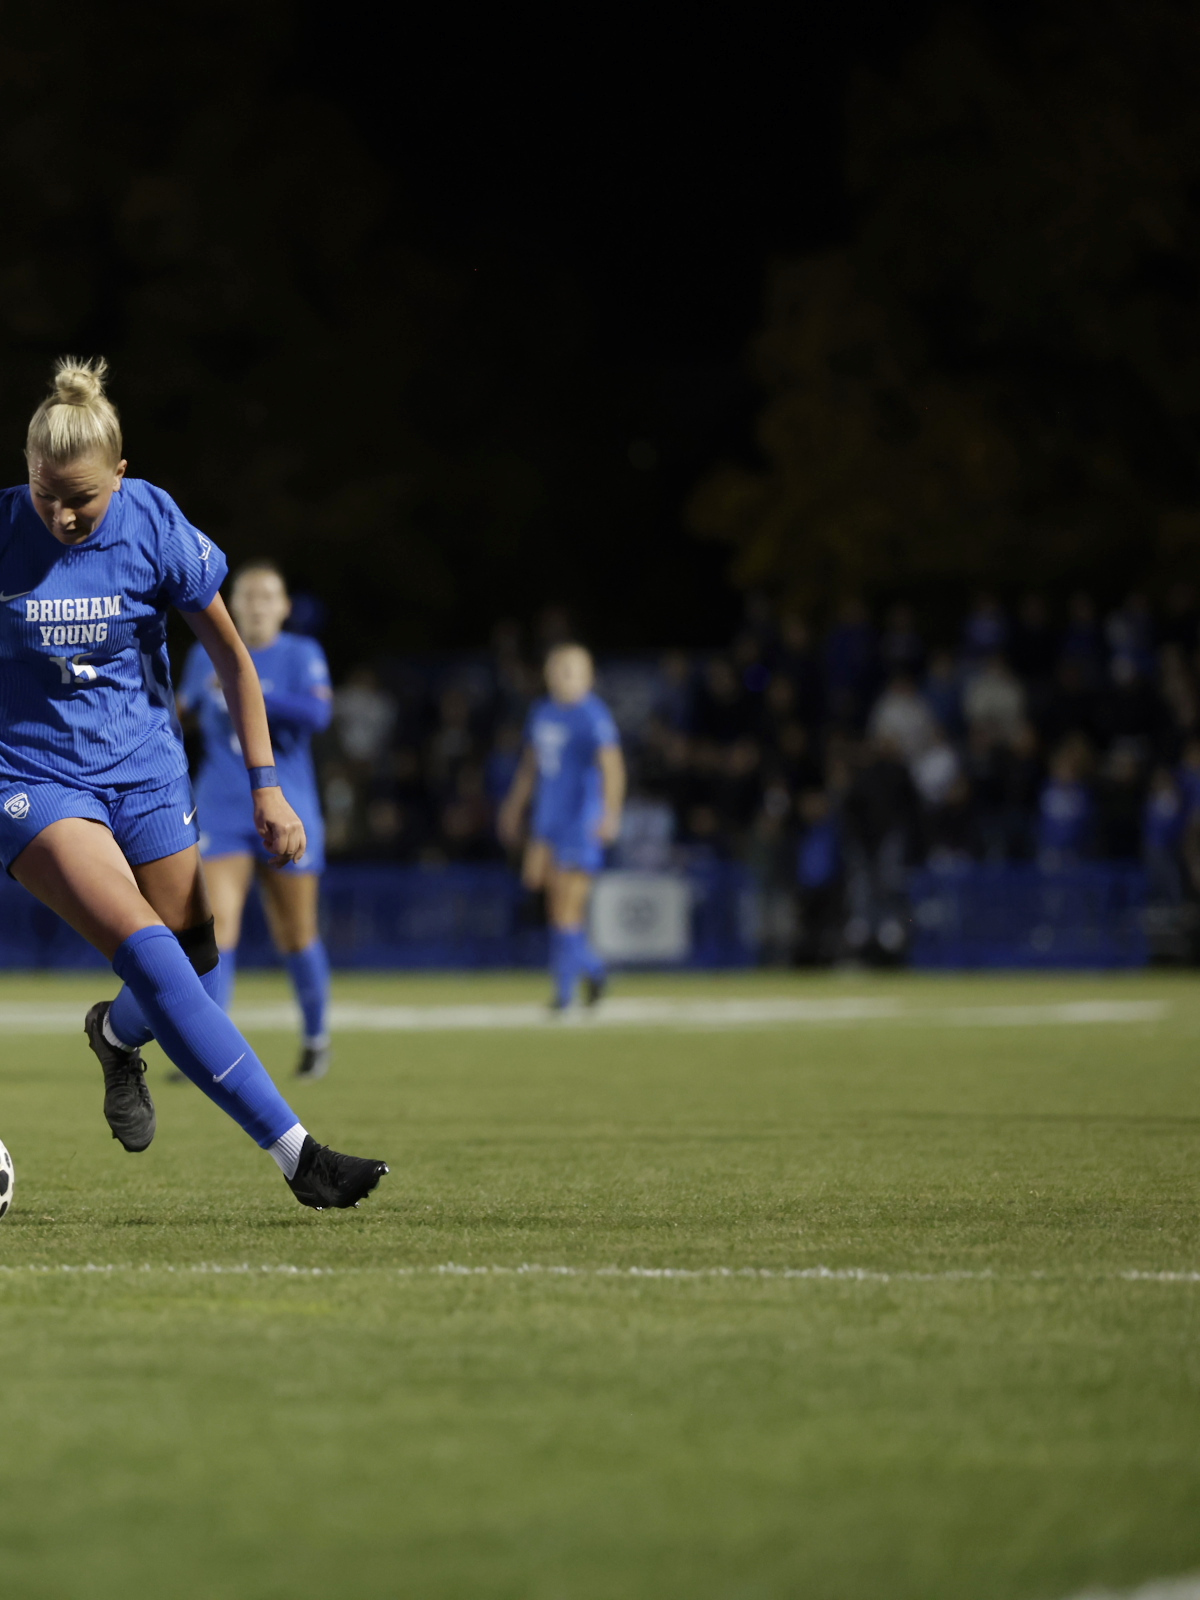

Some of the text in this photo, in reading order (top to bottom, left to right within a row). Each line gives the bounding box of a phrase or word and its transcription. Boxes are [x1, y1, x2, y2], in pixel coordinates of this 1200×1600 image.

[25, 595, 122, 622] BRIGHAM
[39, 623, 108, 646] YOUNG
[49, 652, 97, 684] 15
